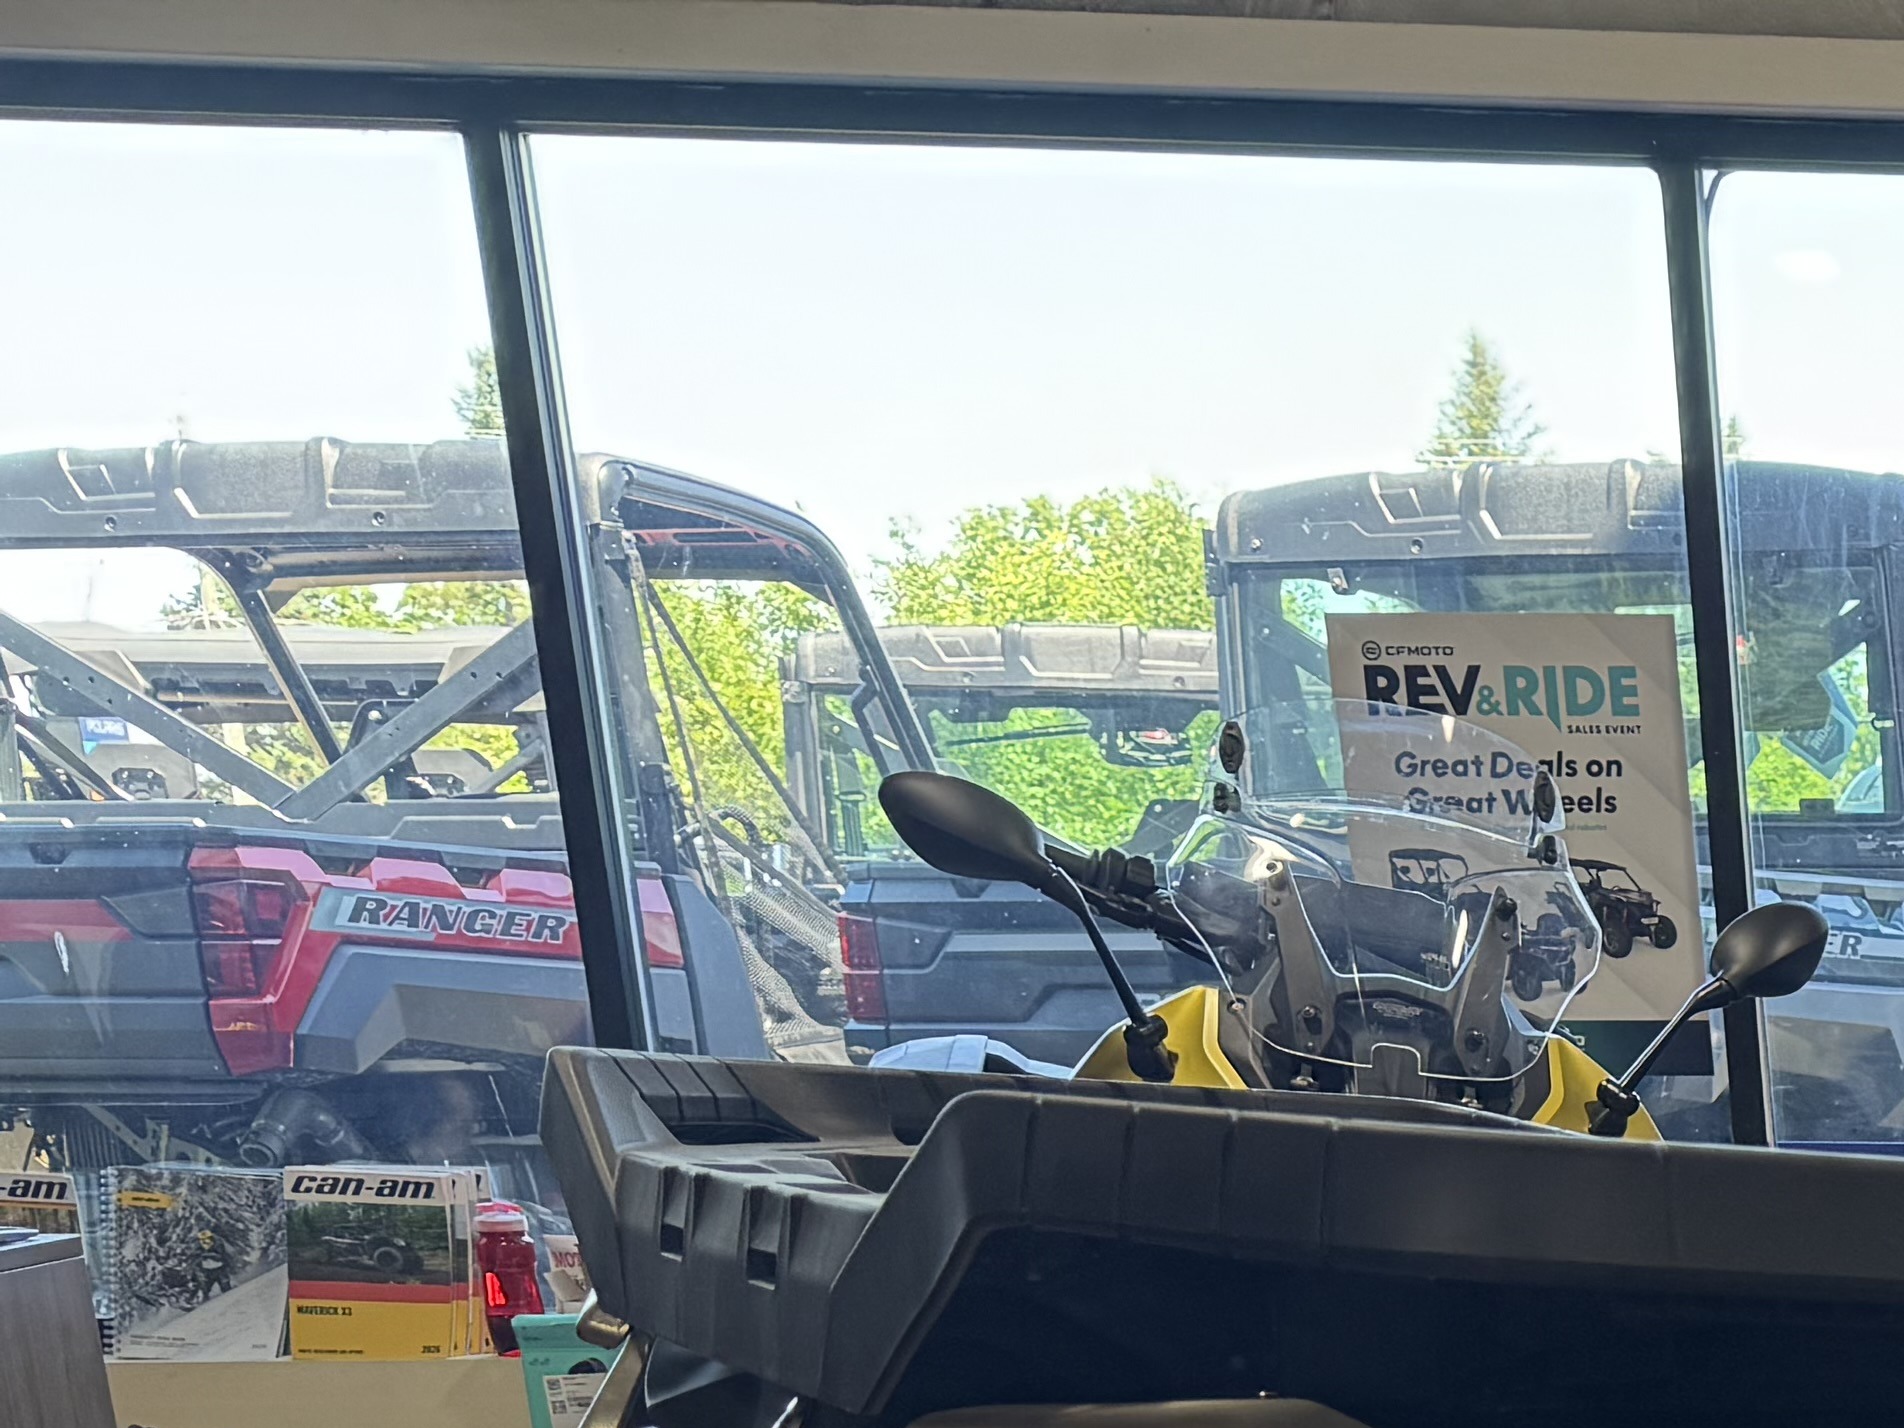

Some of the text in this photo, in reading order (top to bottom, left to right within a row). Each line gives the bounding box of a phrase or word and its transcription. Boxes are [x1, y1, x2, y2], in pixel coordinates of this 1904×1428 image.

[1385, 646, 1454, 656] CFMOTO
[1567, 725, 1641, 735] SALES EVENT
[1395, 751, 1484, 778] Great
[1585, 758, 1623, 778] on
[1408, 787, 1618, 816] Great Weels
[347, 895, 568, 944] RANGER
[291, 1174, 435, 1200] can-am
